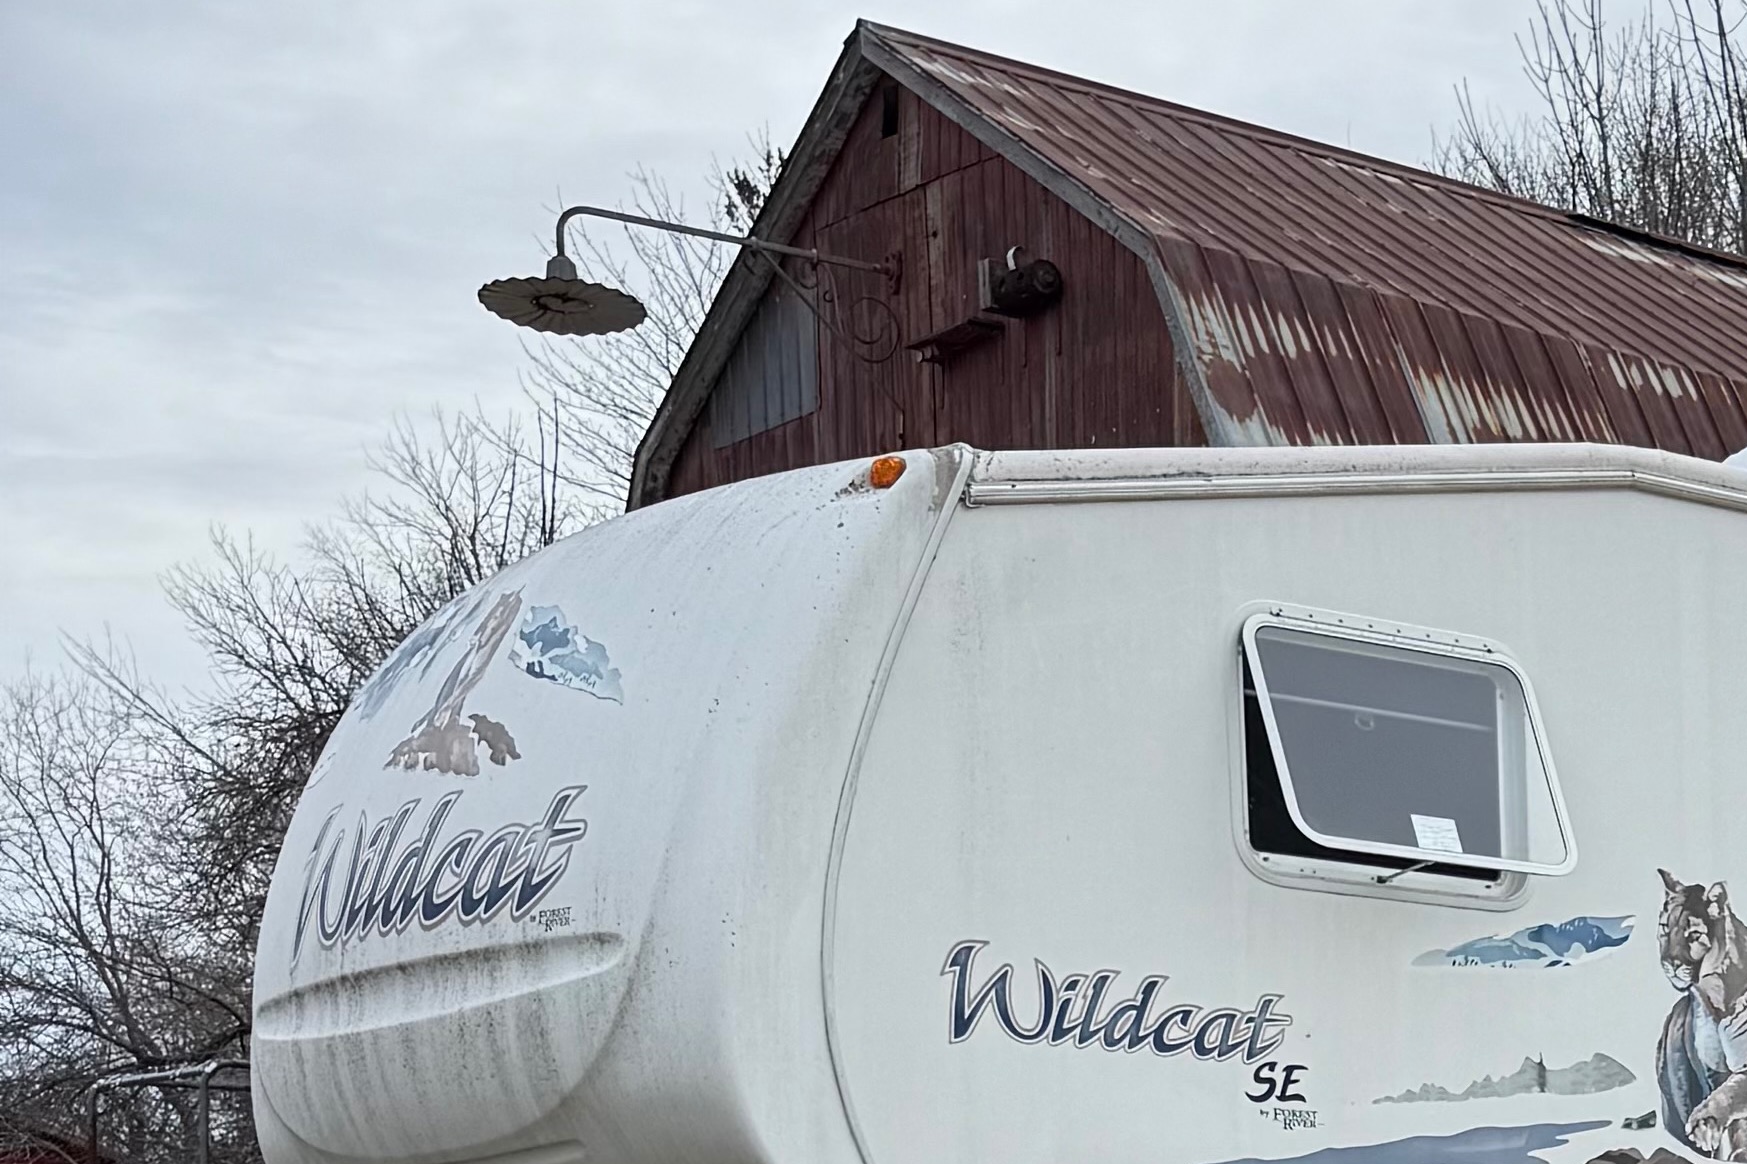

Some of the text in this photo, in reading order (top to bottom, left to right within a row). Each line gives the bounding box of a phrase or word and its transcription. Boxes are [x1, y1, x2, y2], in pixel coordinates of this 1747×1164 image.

[290, 785, 588, 975] Wildcat
[940, 939, 1293, 1065] Wildcat
[1244, 1061, 1309, 1103] SE
